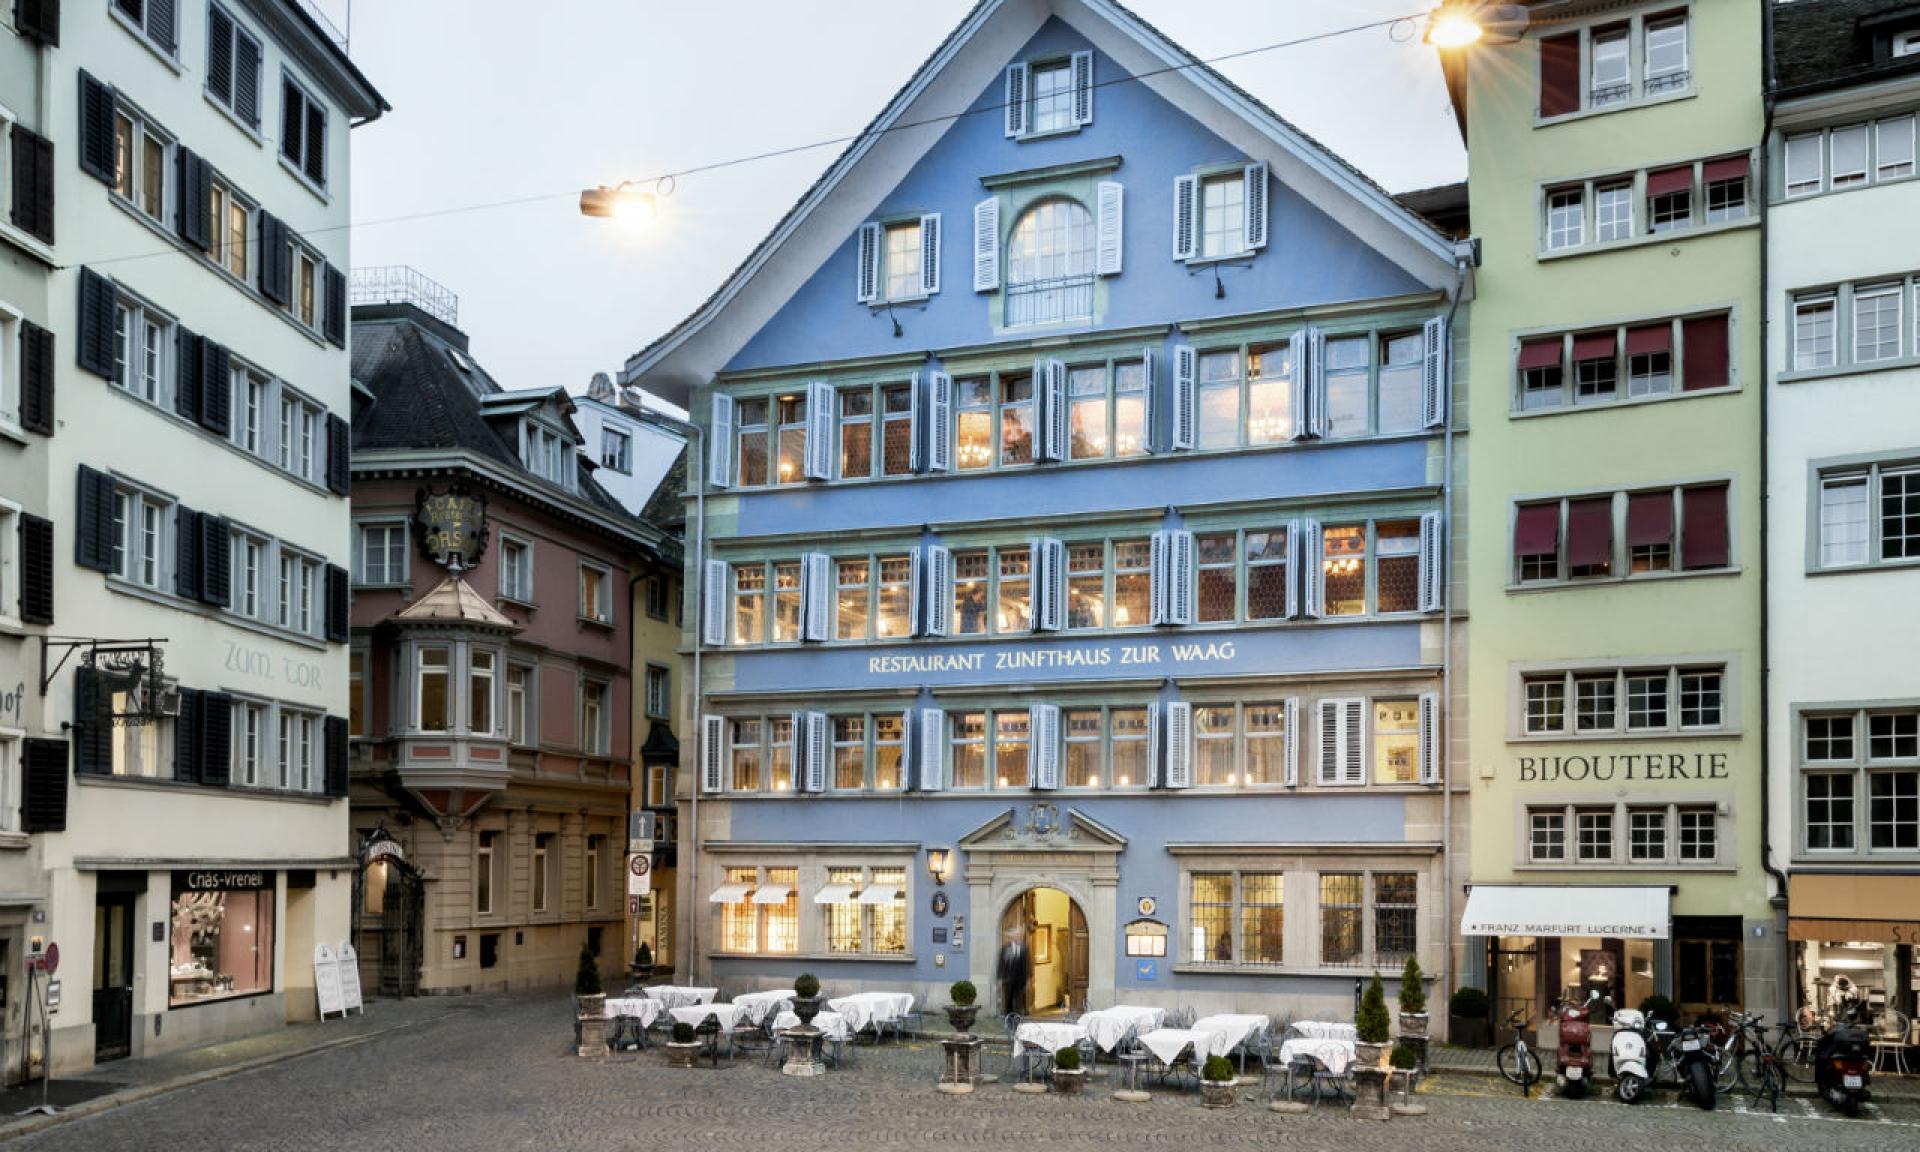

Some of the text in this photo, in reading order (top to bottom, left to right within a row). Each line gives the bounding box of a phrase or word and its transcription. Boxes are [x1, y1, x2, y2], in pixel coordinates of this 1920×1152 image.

[869, 641, 1236, 673] RESTAURANT ZUNFTHAUS ZUR WAAG
[0, 681, 25, 724] of
[1518, 752, 1730, 782] BIJOUTERIE
[1480, 923, 1646, 935] FRANZ MARFURT LUCERNE
